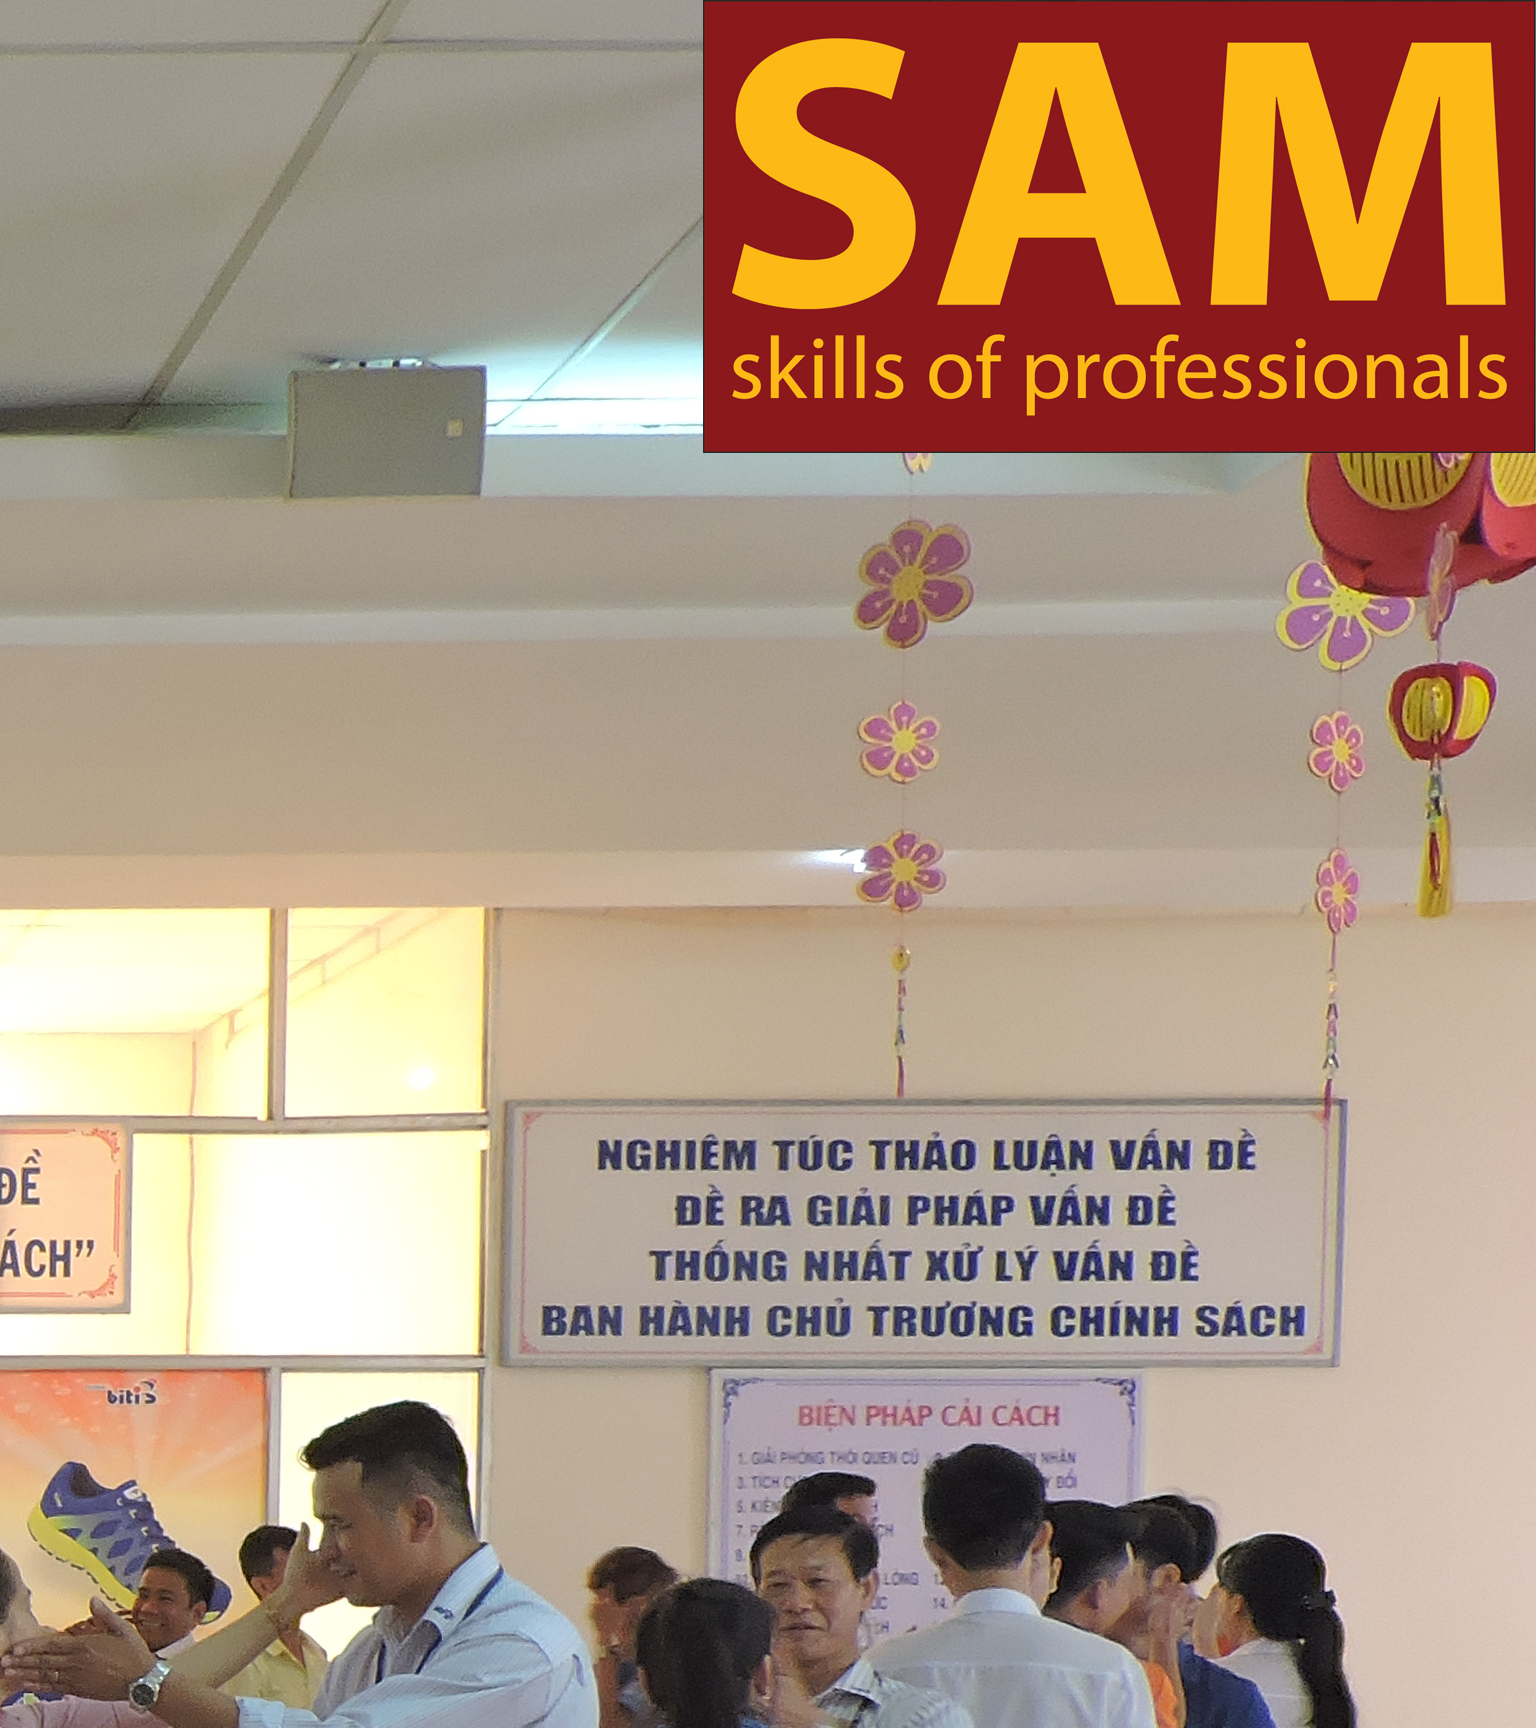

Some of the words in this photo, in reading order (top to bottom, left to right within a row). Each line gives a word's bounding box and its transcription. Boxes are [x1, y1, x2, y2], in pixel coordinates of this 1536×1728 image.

[597, 1133, 757, 1172] NGHIÊM
[772, 1134, 854, 1172] TÚC
[868, 1131, 977, 1172] THẢO
[993, 1133, 1094, 1178] LUẬN
[1108, 1127, 1192, 1172] VẤN
[1205, 1127, 1258, 1171] ĐỀ
[673, 1184, 725, 1227] ĐỀ
[740, 1194, 792, 1227] RA
[806, 1187, 892, 1227] GIẢI
[907, 1189, 1016, 1227] PHÁP
[1028, 1183, 1111, 1227] VẤN
[1125, 1183, 1177, 1227] ĐỀ
[649, 1239, 789, 1282] THỐNG
[803, 1239, 913, 1282] NHẤT
[925, 1242, 985, 1282] XỬ
[995, 1245, 1040, 1282] LÝ
[1053, 1239, 1135, 1282] VẤN
[1148, 1239, 1200, 1282] ĐỀ
[541, 1304, 624, 1337] BAN
[639, 1299, 751, 1337] HÀNH
[766, 1297, 853, 1337] CHỦ
[866, 1300, 1035, 1338] TRƯƠNG
[1049, 1300, 1180, 1338] CHÍNH
[1195, 1300, 1306, 1338] SÁCH
[798, 1398, 856, 1431] BIỆN
[865, 1400, 933, 1427] PHÁP
[941, 1398, 983, 1427] CẢI
[991, 1399, 1060, 1427] CÁCH
